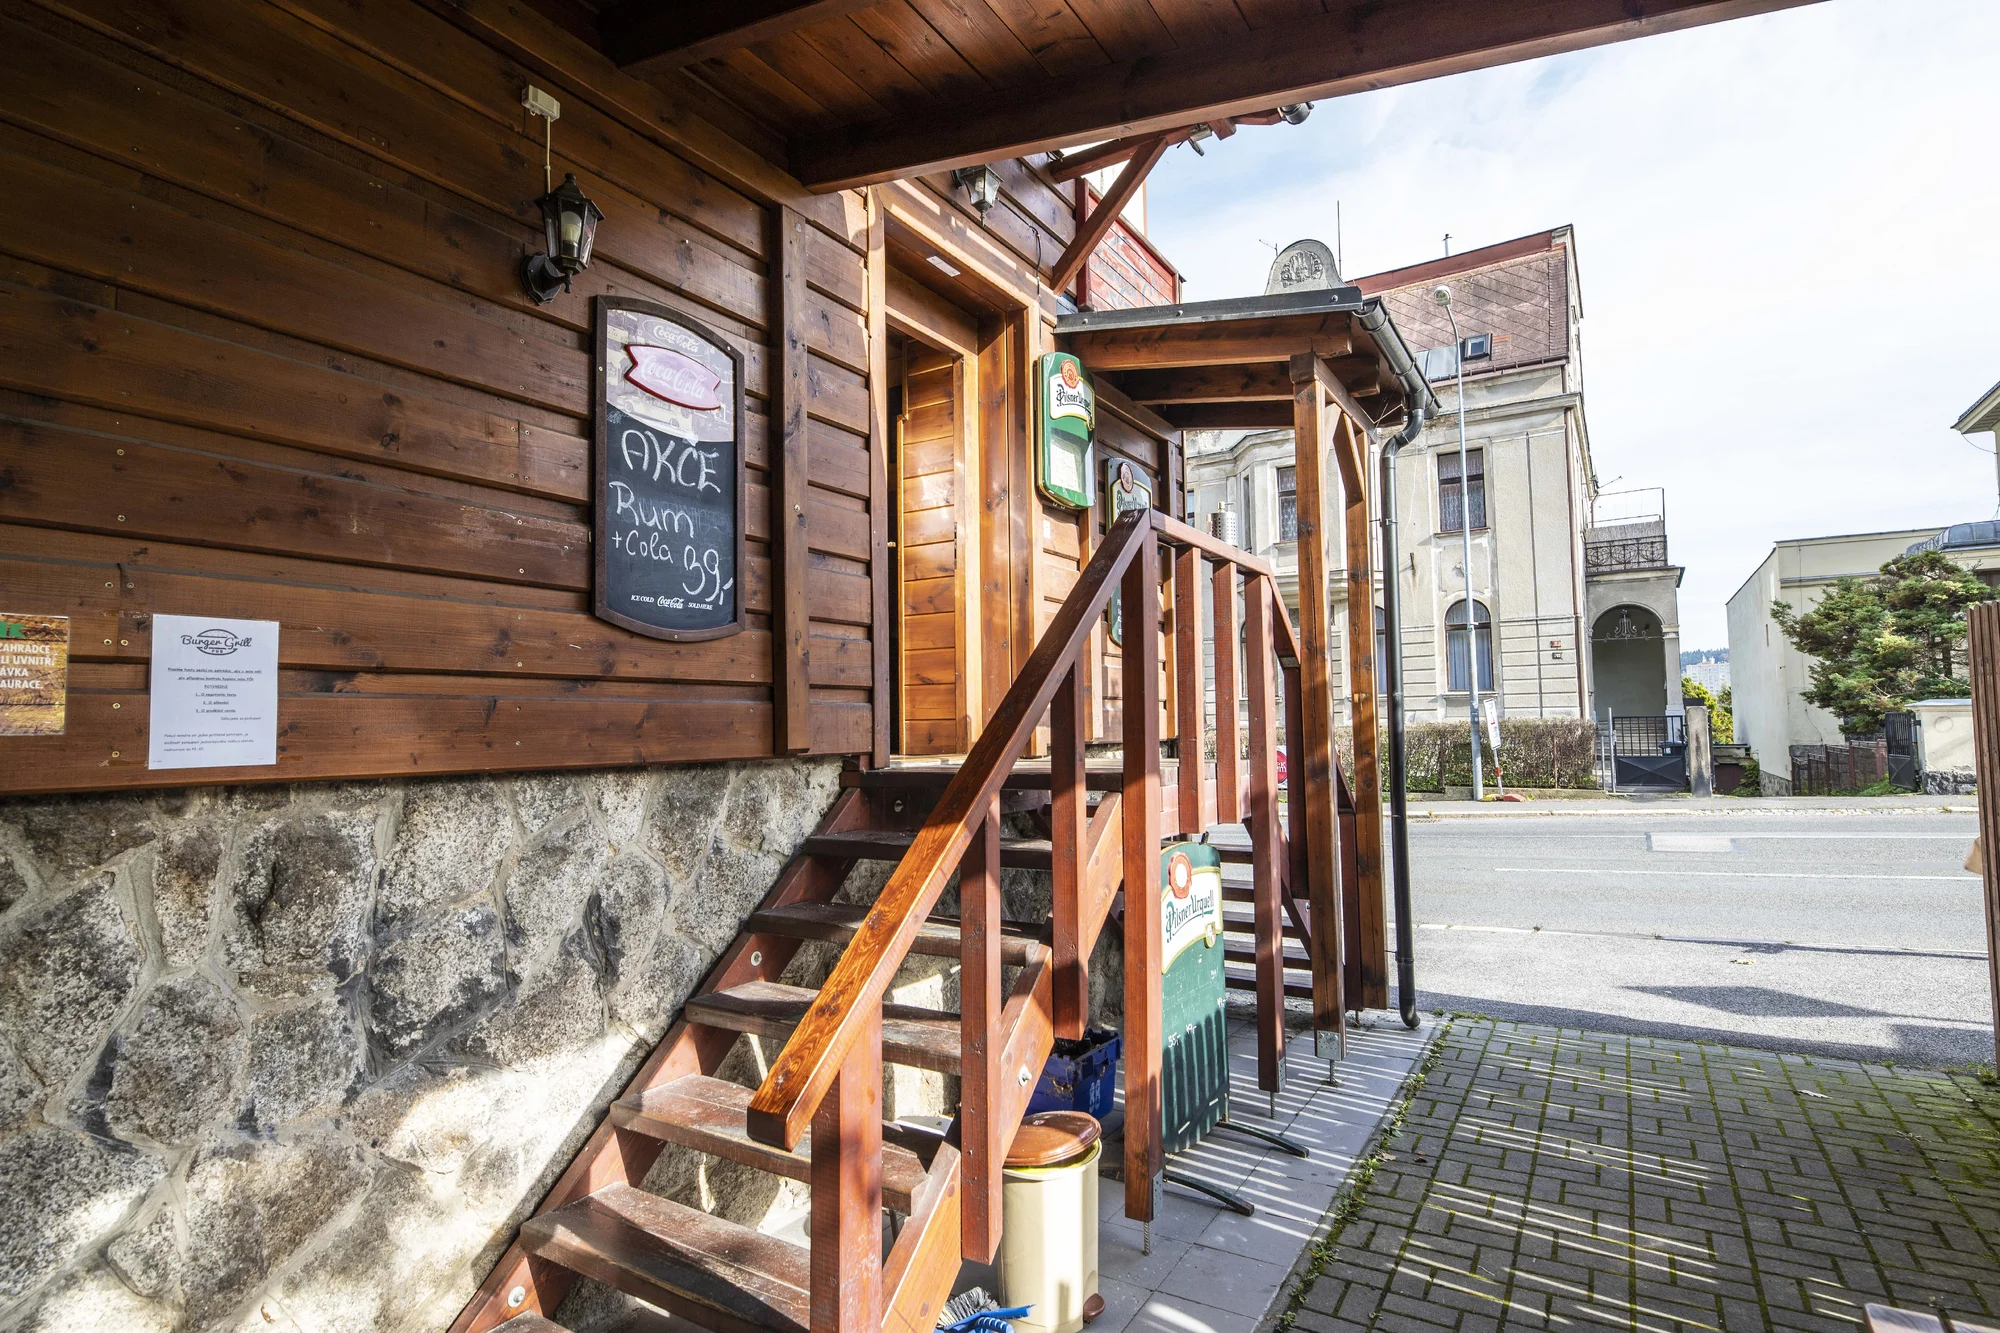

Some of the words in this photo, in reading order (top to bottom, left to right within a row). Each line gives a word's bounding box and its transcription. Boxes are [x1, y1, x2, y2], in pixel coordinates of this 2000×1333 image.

[641, 356, 707, 399] Coca-Cola
[609, 481, 694, 538] Rum
[657, 596, 685, 609] Coca-Cola
[181, 634, 222, 650] Burger
[224, 637, 253, 650] Grill
[1166, 901, 1191, 943] Pilsner
[1191, 889, 1214, 918] Urquell
